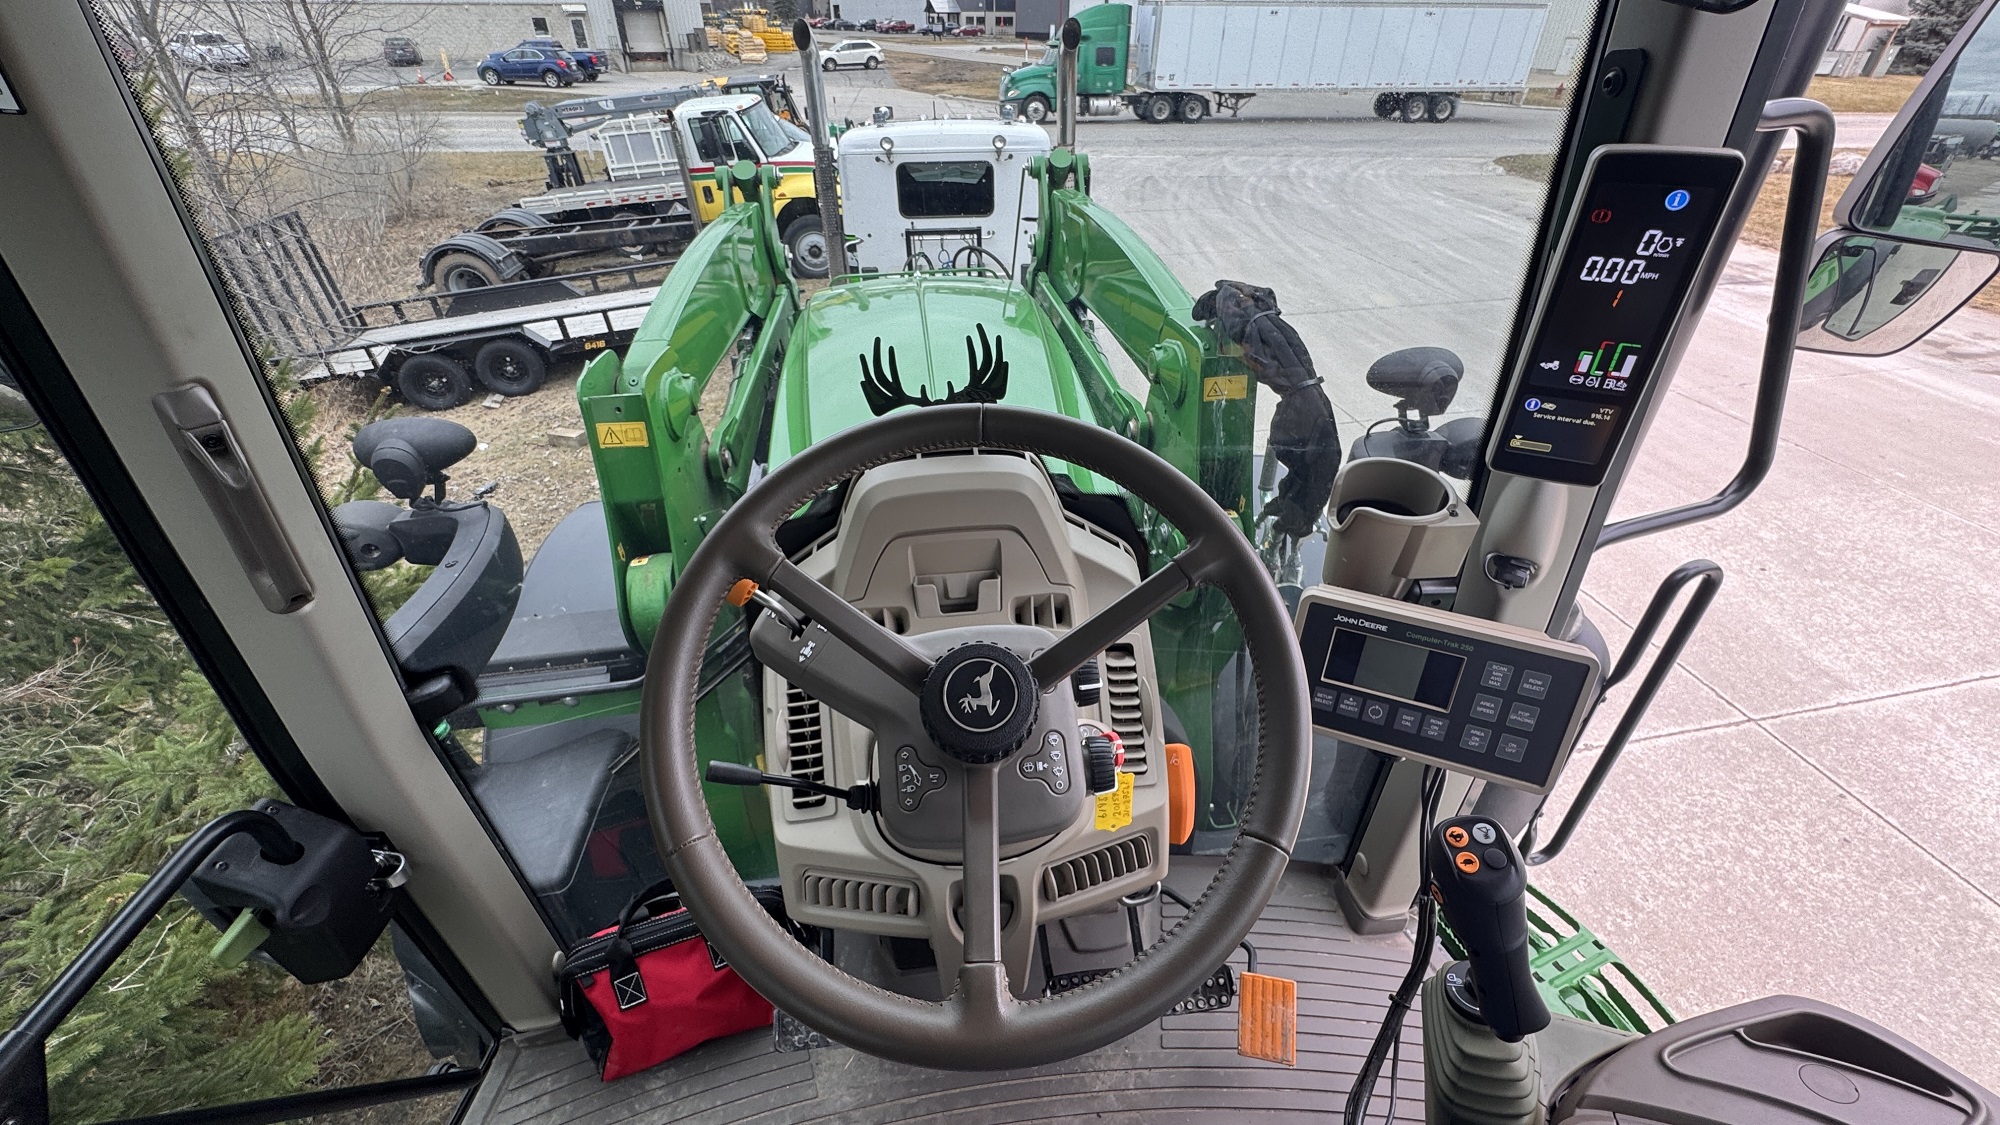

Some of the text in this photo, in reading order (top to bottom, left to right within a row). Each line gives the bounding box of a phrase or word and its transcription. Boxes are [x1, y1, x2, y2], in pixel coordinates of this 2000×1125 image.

[1636, 229, 1663, 256] 0
[1580, 255, 1660, 285] 0.00 MPH
[1599, 407, 1615, 415] VTV
[1533, 412, 1556, 421] Service
[1557, 416, 1582, 424] interval
[1333, 614, 1388, 633] JOHN DEERE
[1460, 644, 1474, 652] 250
[1492, 664, 1508, 672] SCAN
[1523, 683, 1545, 692] SELECT
[1316, 692, 1333, 700] SETUP
[1314, 697, 1333, 706] SELECT
[1480, 700, 1495, 708] AREA
[1340, 704, 1359, 712] SELECT
[1476, 706, 1495, 715] SPEED
[1430, 718, 1444, 726] ROW
[1510, 714, 1534, 725] SPACING
[1470, 729, 1485, 737] AREA
